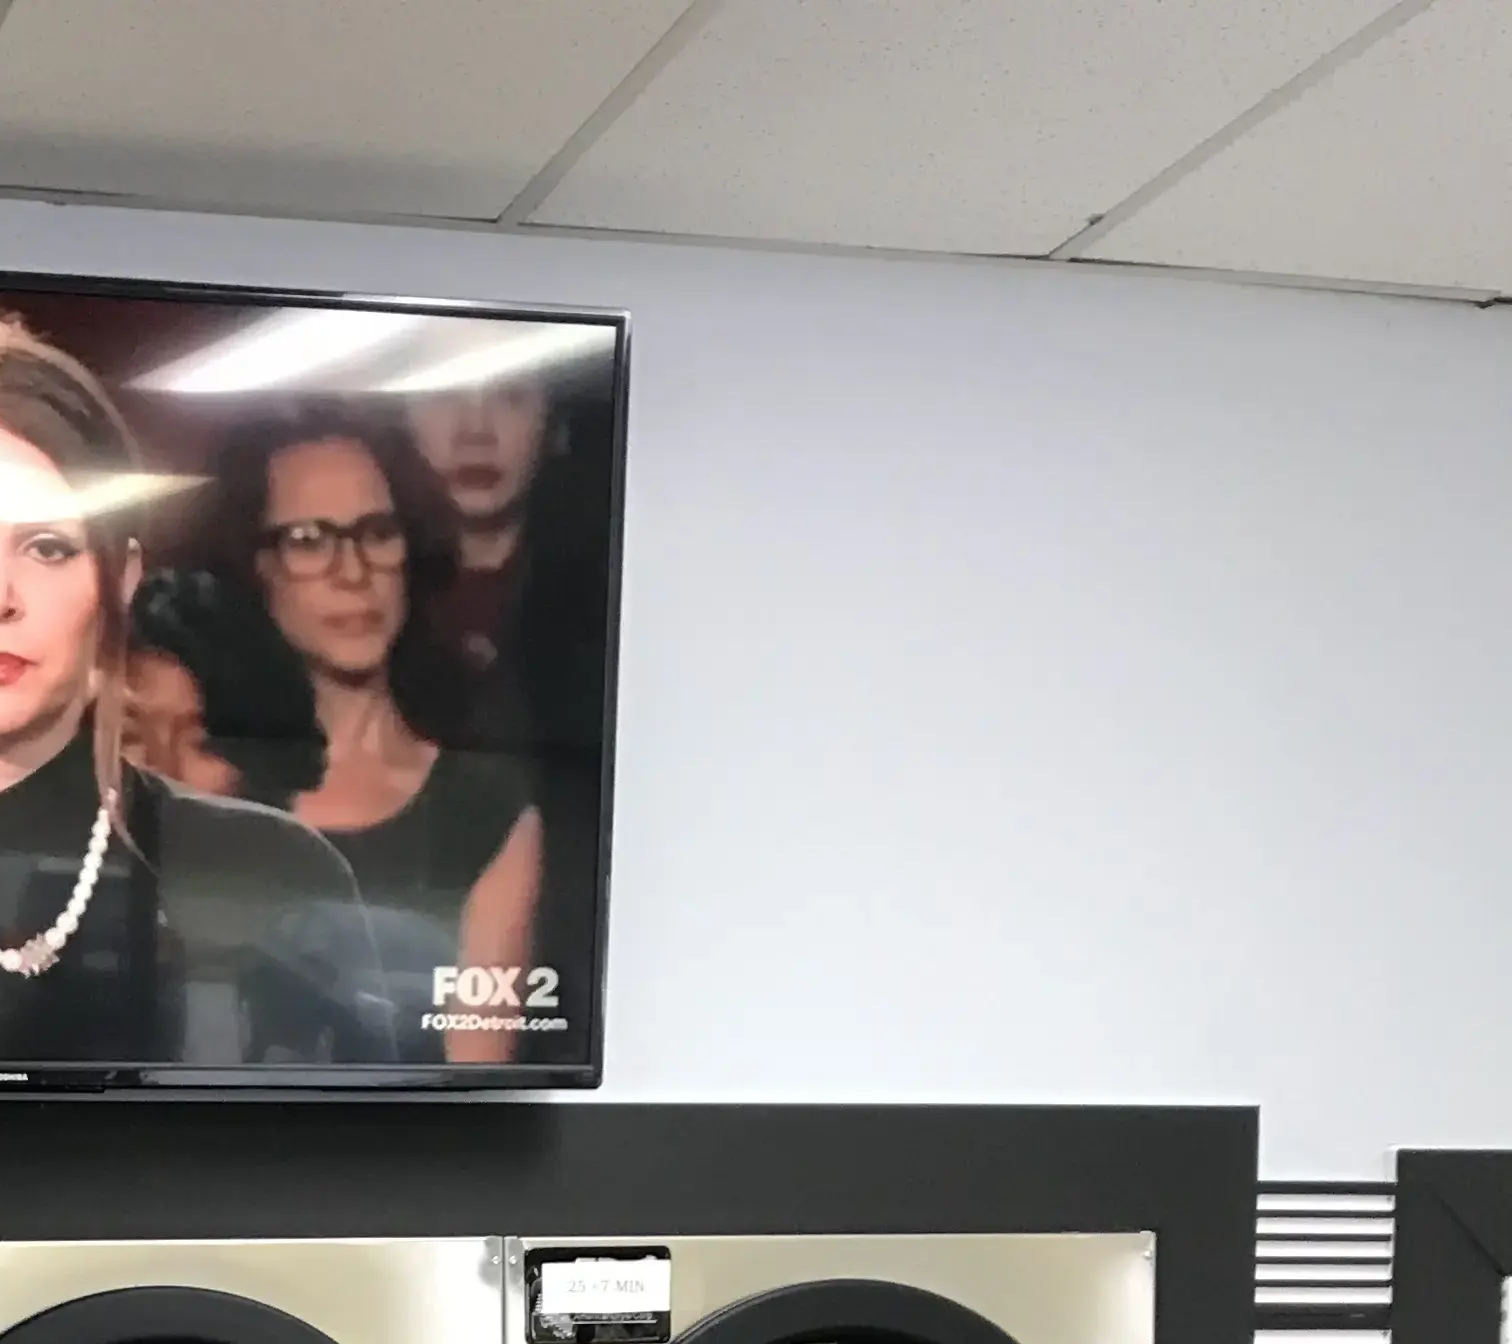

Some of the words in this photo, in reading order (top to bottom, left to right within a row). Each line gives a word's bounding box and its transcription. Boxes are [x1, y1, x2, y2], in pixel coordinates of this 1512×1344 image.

[433, 966, 522, 1007] FOX
[525, 967, 560, 1008] 2
[421, 1013, 568, 1031] FOX2Detroit.com
